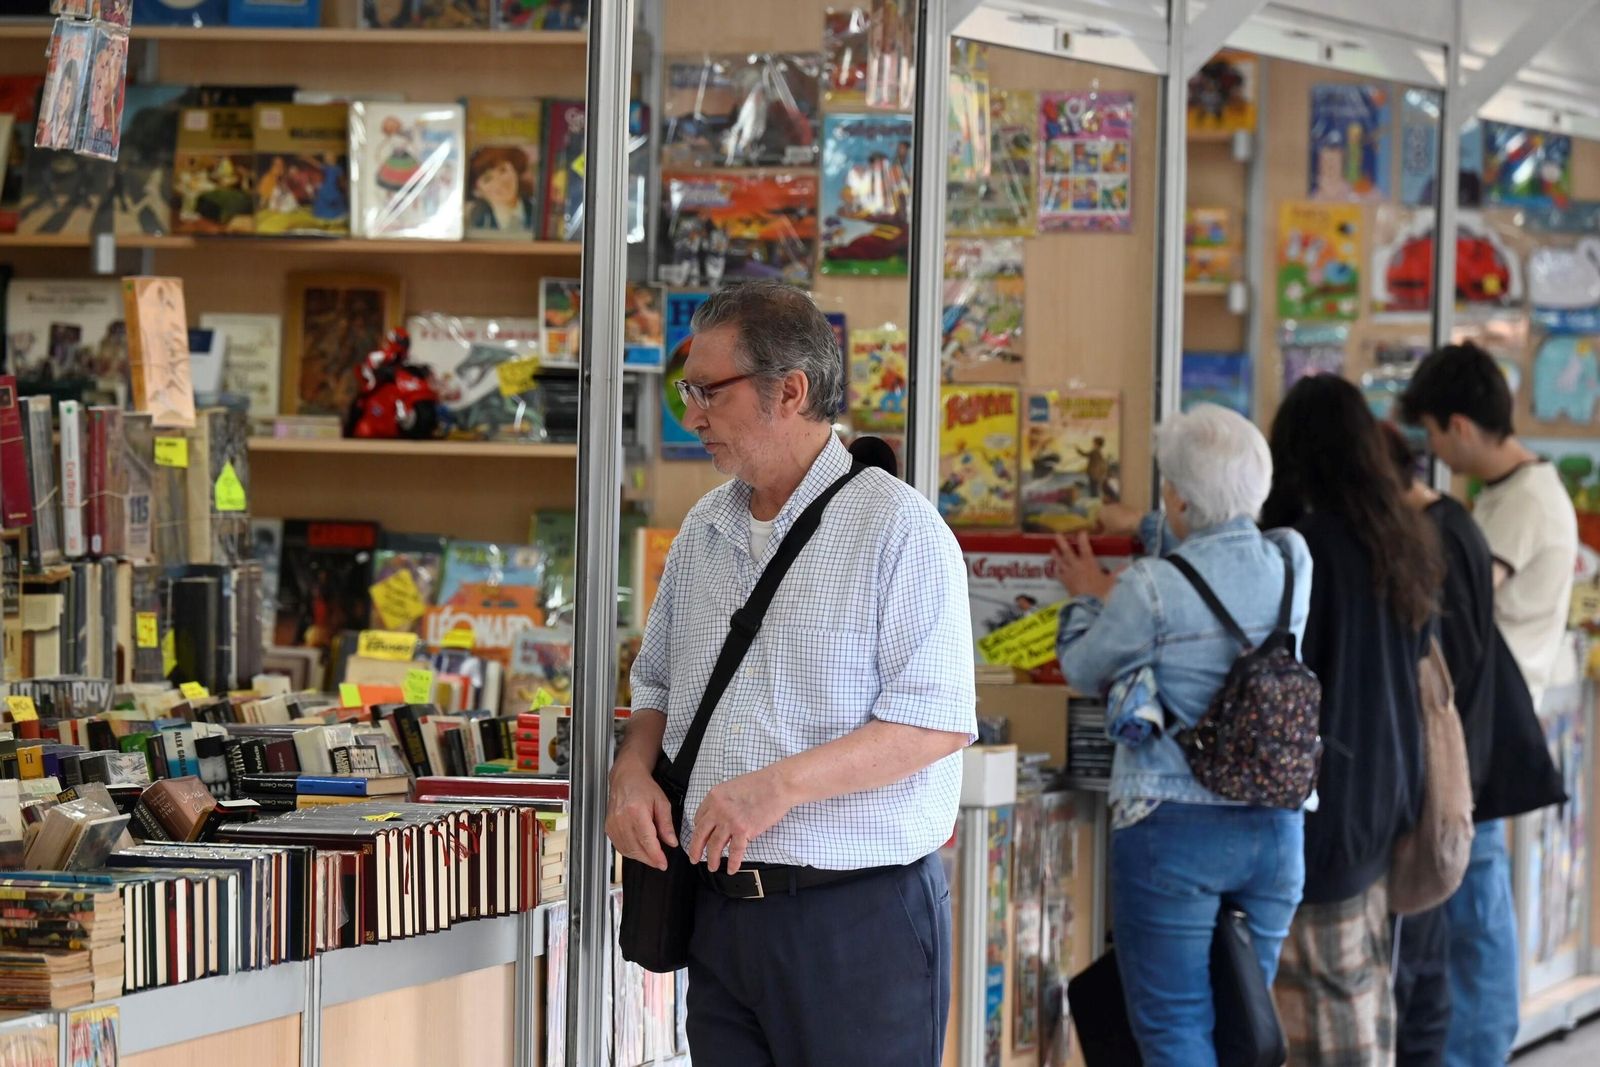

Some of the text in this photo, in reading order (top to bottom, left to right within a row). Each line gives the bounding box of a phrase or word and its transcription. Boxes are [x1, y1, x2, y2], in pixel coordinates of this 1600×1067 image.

[129, 495, 149, 523] 115
[972, 557, 1042, 582] Capitán
[72, 681, 109, 709] muy
[174, 731, 185, 749] ALEX
